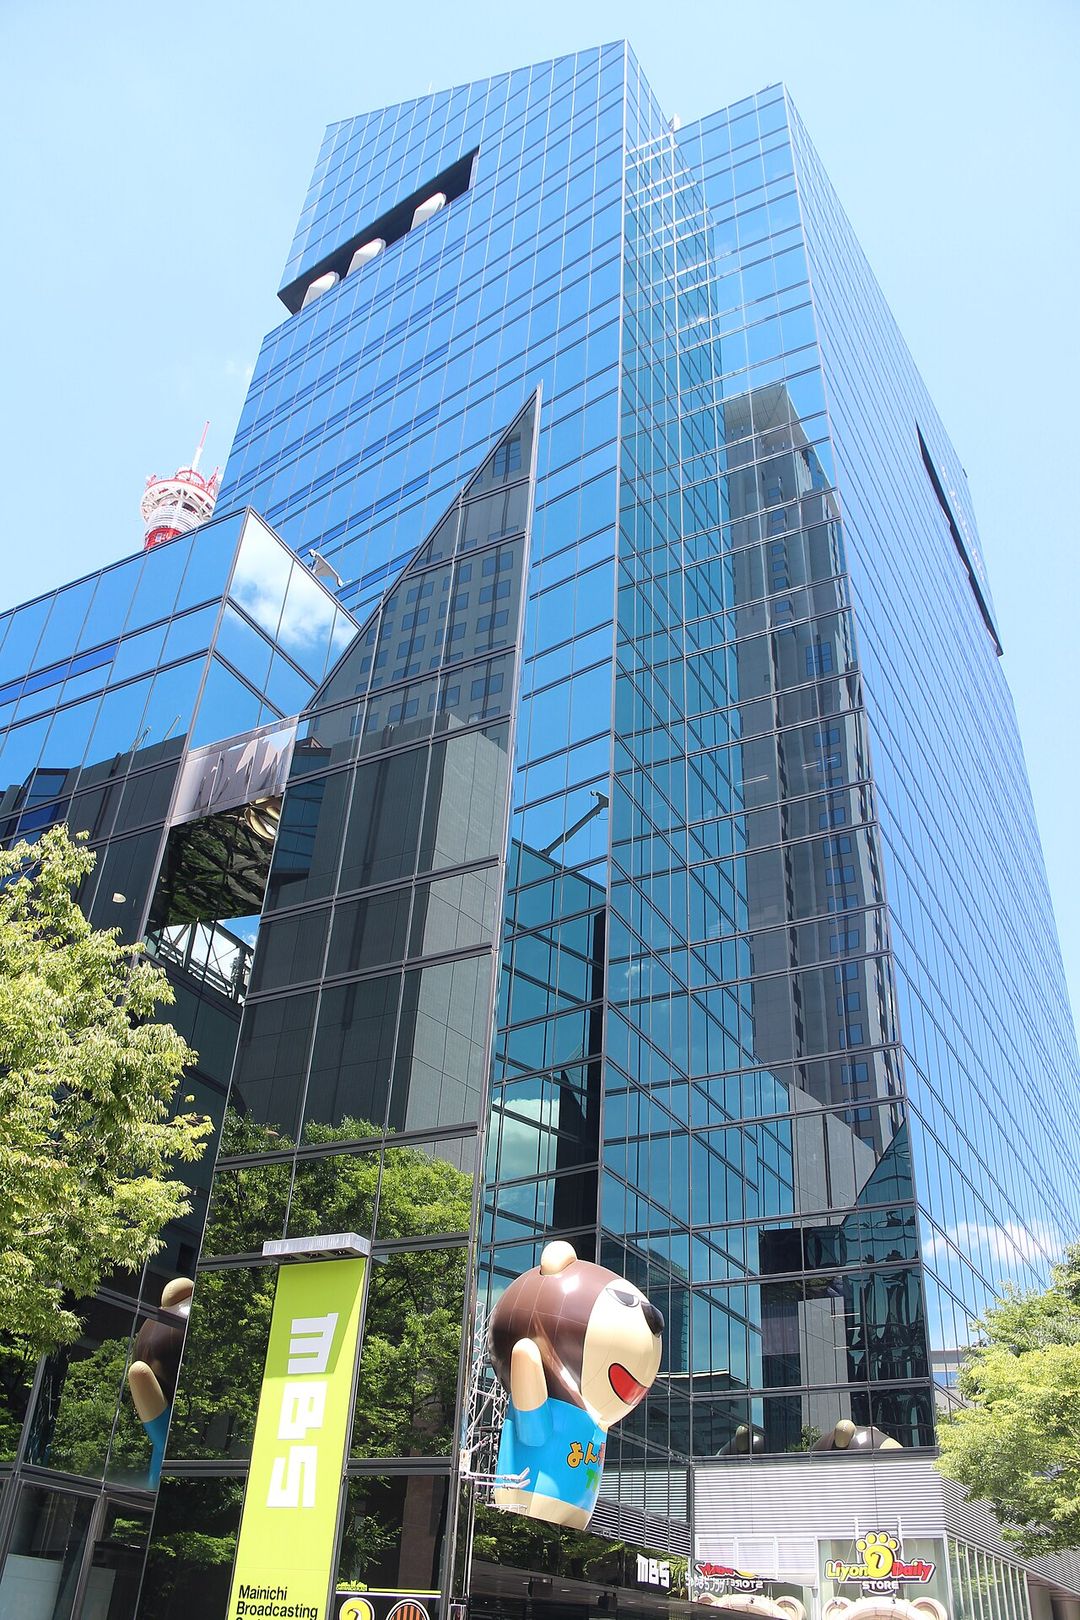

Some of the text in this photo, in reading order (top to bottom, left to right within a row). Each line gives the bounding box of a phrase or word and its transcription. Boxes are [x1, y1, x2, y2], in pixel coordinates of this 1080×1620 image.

[266, 1312, 339, 1508] MBS
[636, 1553, 670, 1588] MBS
[827, 1561, 932, 1581] Liyon Daily
[238, 1584, 288, 1601] Mainichi
[862, 1581, 899, 1590] STORE
[236, 1601, 318, 1620] Broadcasting
